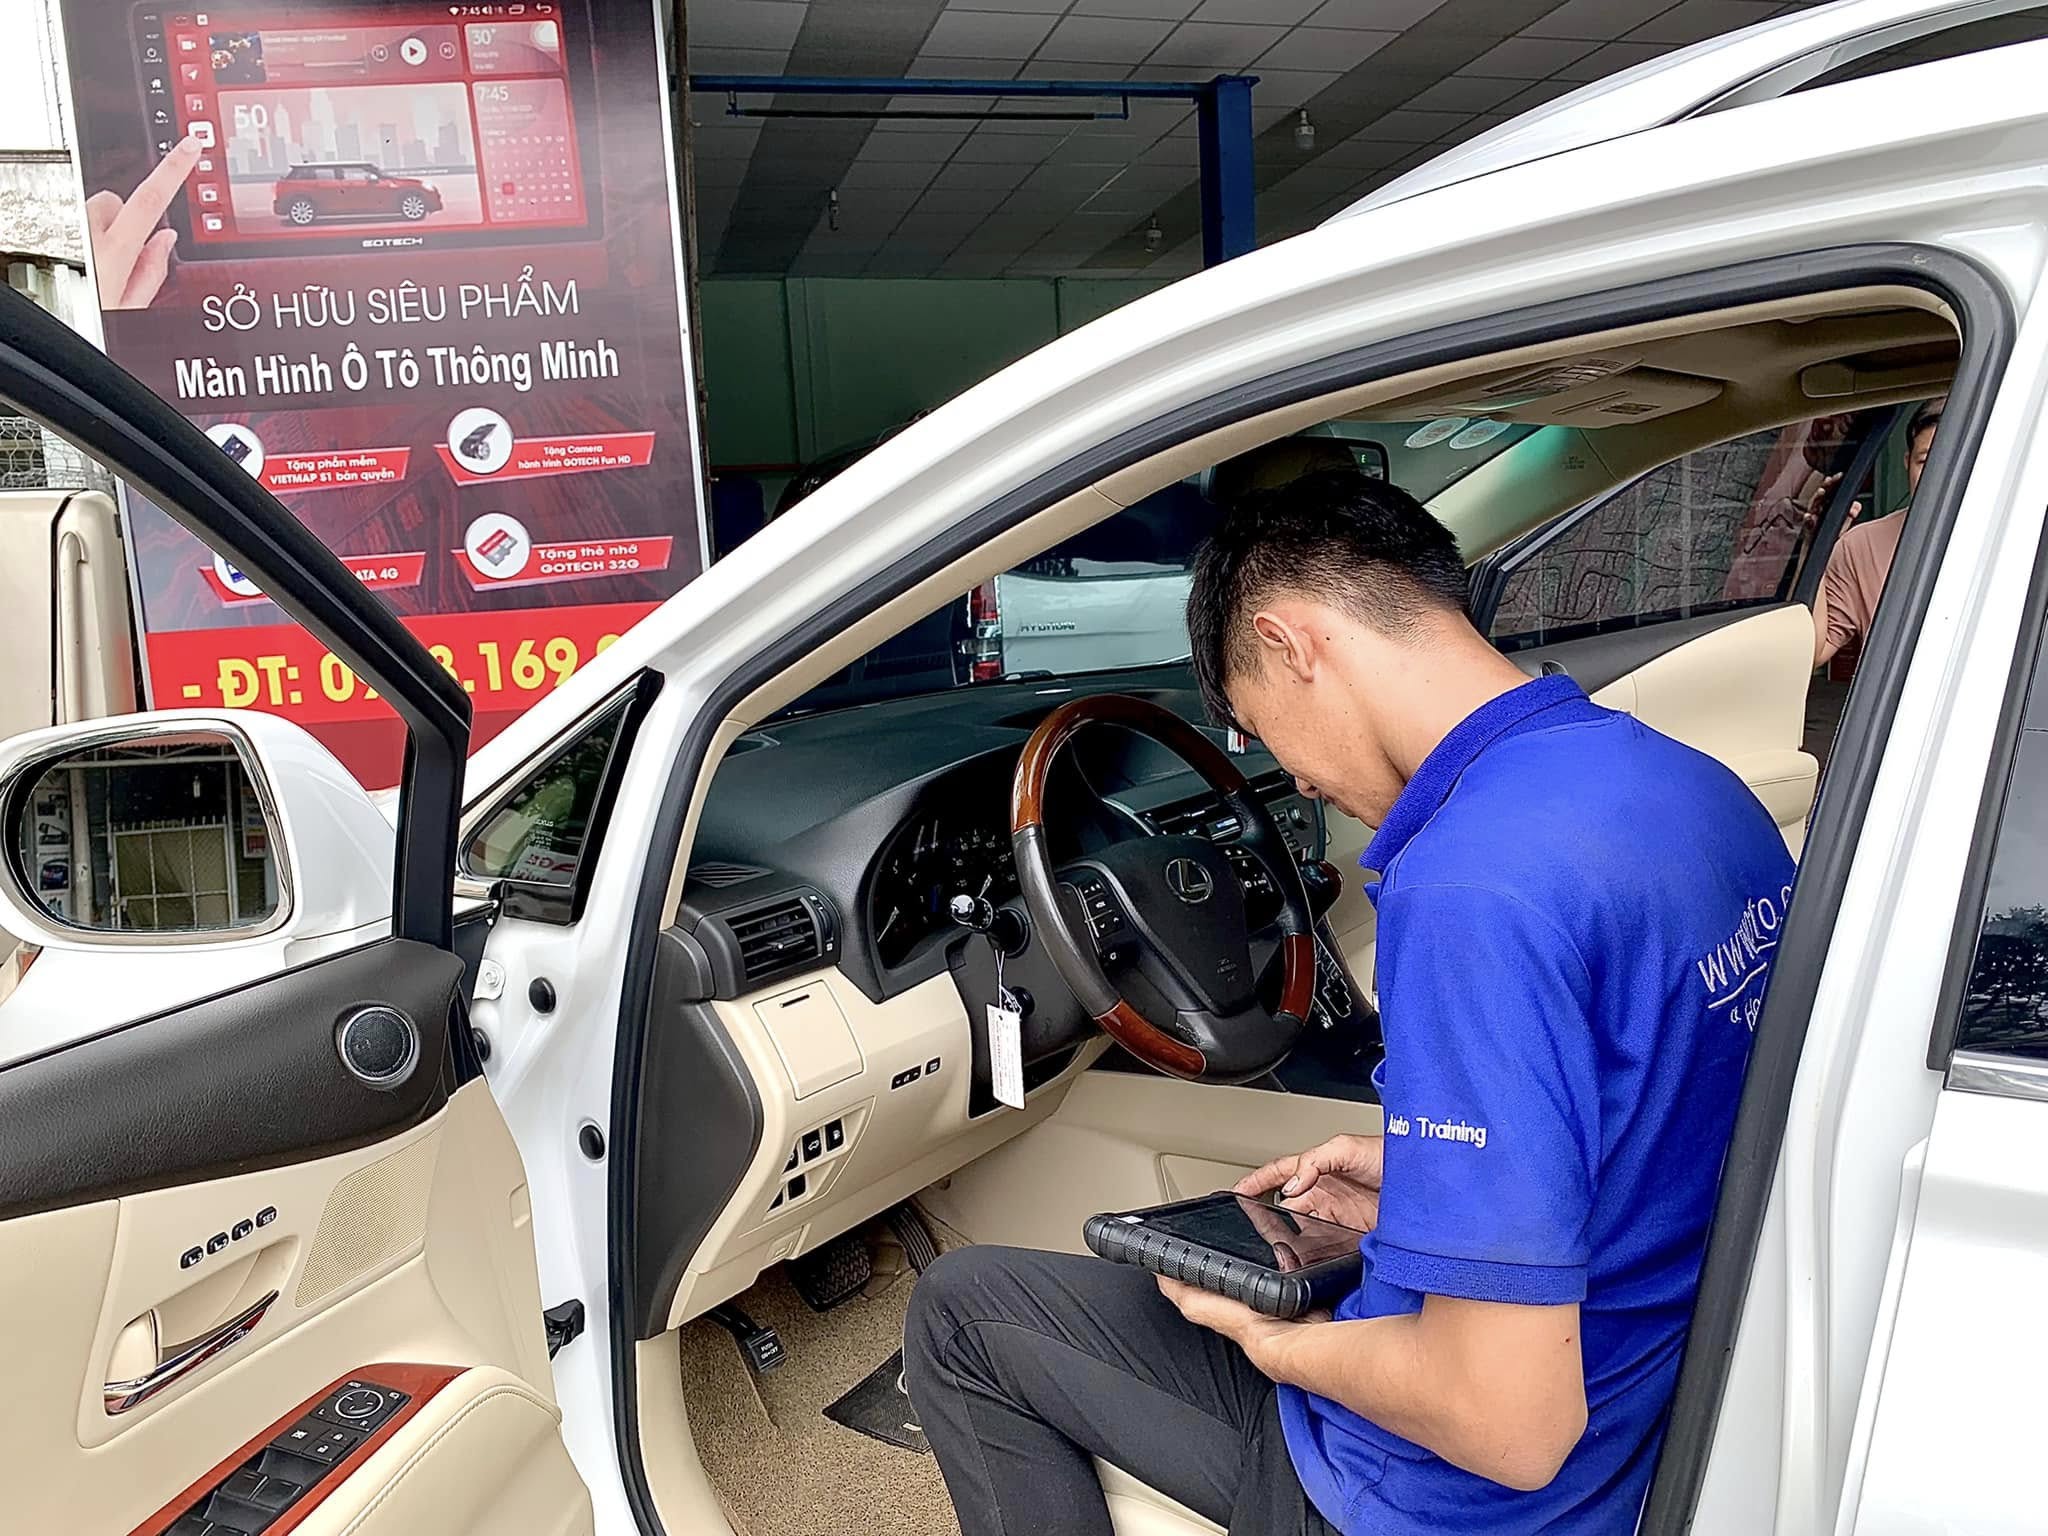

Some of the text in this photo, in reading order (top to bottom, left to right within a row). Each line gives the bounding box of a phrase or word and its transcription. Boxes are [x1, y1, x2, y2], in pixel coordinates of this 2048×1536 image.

[233, 104, 268, 129] 50
[202, 265, 580, 332] SỞ HỮU SIÊU PHẨM
[174, 339, 620, 399] Màn Hình Ô Tô Thông Minh
[567, 445, 603, 454] Camera
[563, 456, 600, 467] GOTECH
[617, 455, 631, 464] HD
[269, 473, 318, 486] VIETMAP
[319, 472, 332, 483] S1
[355, 567, 399, 581] ATA 4G
[540, 558, 640, 574] GOTECH 32G
[217, 655, 304, 708] ĐT:
[1415, 1116, 1487, 1149] Training
